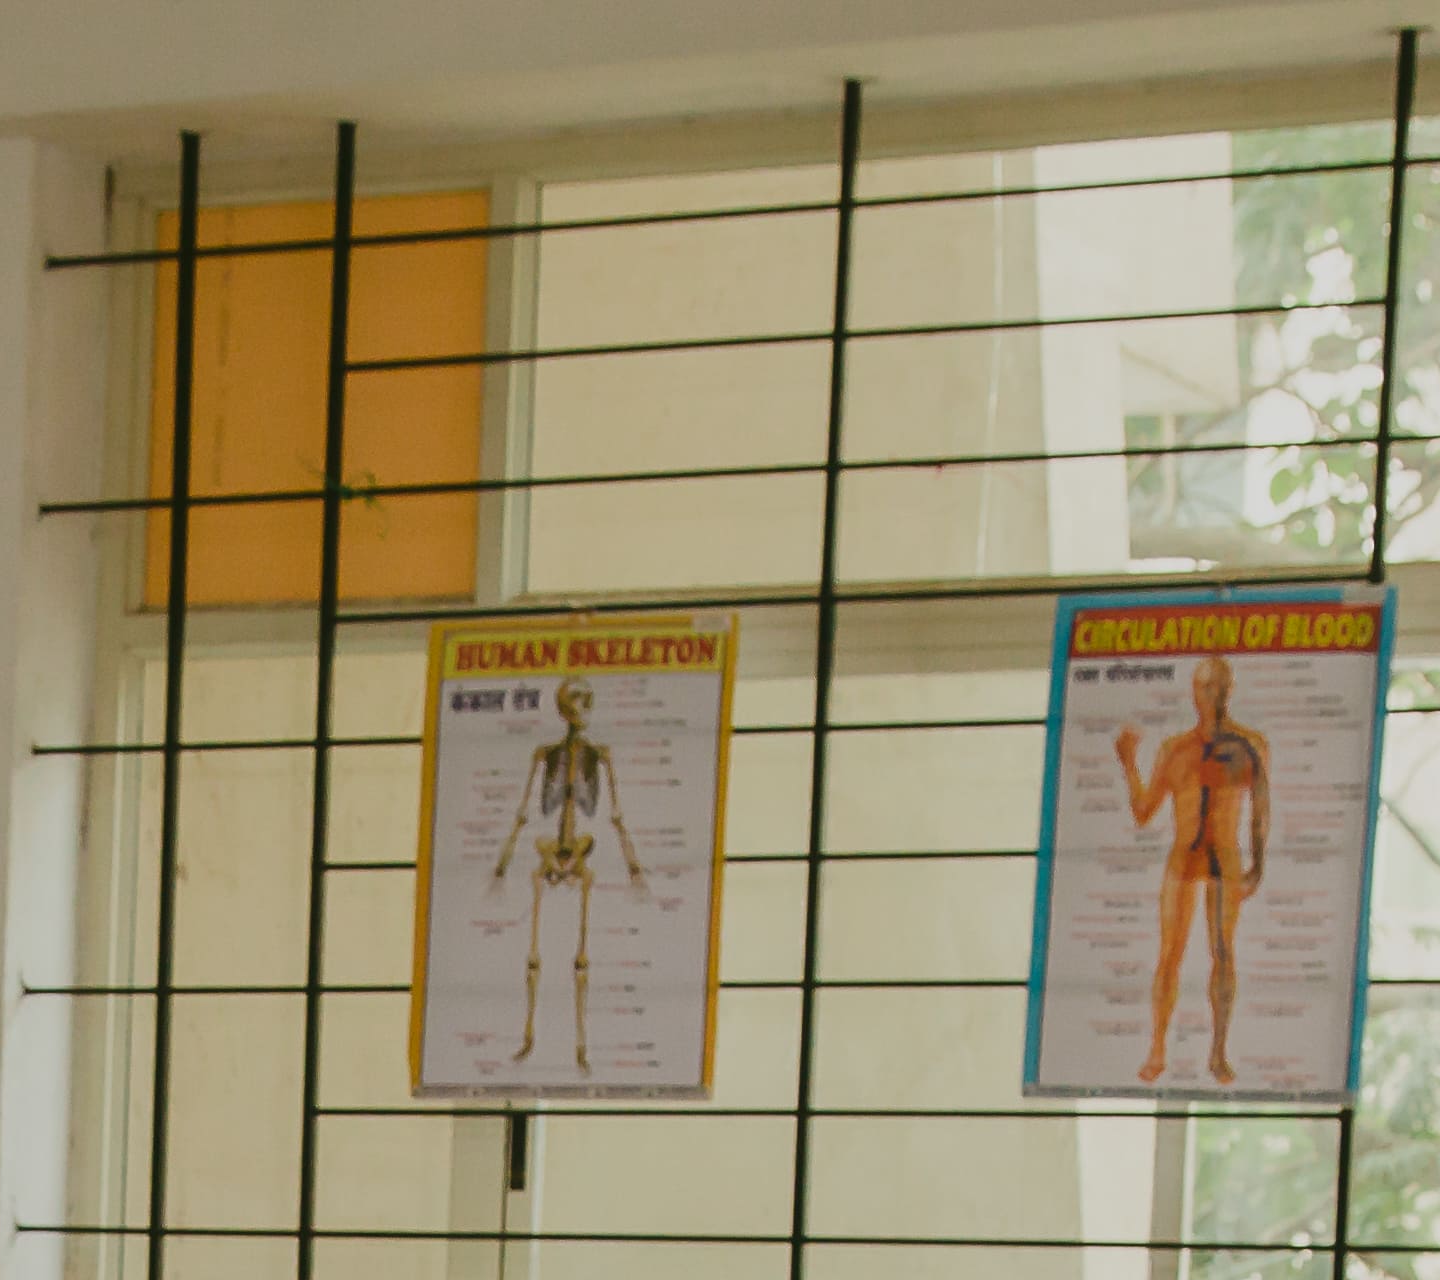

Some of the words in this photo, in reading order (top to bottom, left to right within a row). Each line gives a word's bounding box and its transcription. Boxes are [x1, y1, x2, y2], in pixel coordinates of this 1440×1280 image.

[1074, 615, 1241, 653] CIRCULATION
[1242, 614, 1282, 649] OF
[1281, 612, 1375, 649] BLOOD
[456, 640, 561, 672] HUMAN
[569, 634, 718, 667] SKELETON
